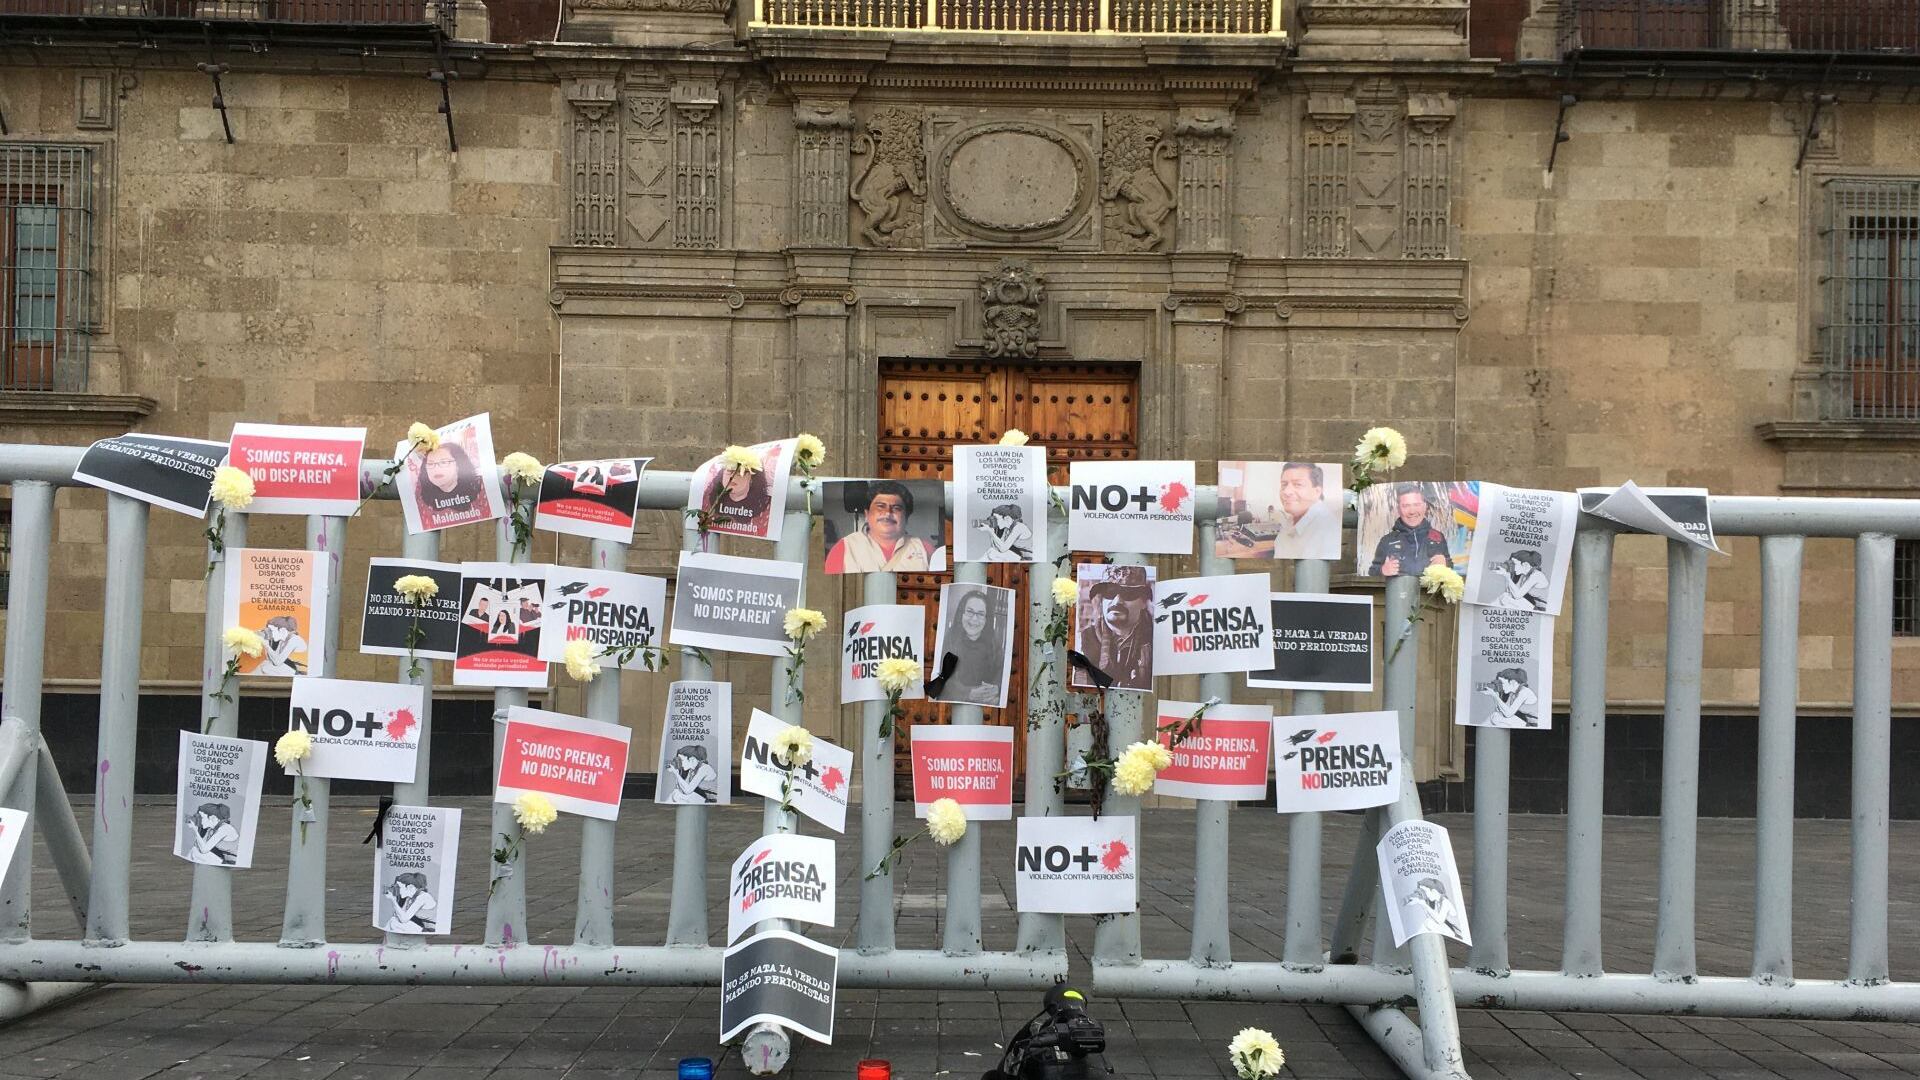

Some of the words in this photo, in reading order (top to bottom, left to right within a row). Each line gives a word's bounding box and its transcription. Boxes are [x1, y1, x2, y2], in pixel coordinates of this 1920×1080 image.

[241, 447, 290, 463] "SOMOS
[294, 451, 347, 467] PRENSA,
[250, 468, 266, 482] NO
[270, 468, 337, 484] DISPAREN"
[435, 495, 470, 509] Lourdes
[1072, 485, 1156, 511] NO+
[432, 507, 481, 525] Maldonado
[720, 503, 753, 517] Lourdes
[370, 594, 381, 602] NO
[382, 595, 392, 603] SE
[688, 582, 734, 602] "SOMOS
[736, 590, 786, 609] PRENSA,
[368, 606, 403, 616] MATANDO
[568, 599, 655, 637] PRENSA,
[694, 604, 709, 617] NO
[712, 605, 776, 624] DISPAREN"
[1172, 606, 1263, 635] PRENSA,
[1173, 633, 1259, 652] NODISPAREN
[1285, 630, 1310, 638] MATA
[1313, 630, 1325, 639] LA
[1328, 631, 1367, 640] VERDAD
[852, 636, 917, 662] PRENSA,
[1300, 642, 1368, 652] PERIODISTAS
[291, 707, 383, 738] NO+
[375, 741, 416, 749] PERIODISTAS
[1215, 738, 1258, 752] PRENSA,
[516, 739, 561, 760] "SOMOS
[564, 748, 613, 772] PRENSA,
[922, 756, 964, 771] "SOMOS
[968, 758, 1004, 773] PRENSA,
[1175, 753, 1189, 766] NO
[1193, 755, 1250, 770] DISPAREN"
[1301, 744, 1392, 772] PRENSA,
[521, 760, 537, 775] NO
[540, 763, 603, 786] DISPAREN"
[931, 776, 944, 789] NO
[947, 775, 998, 790] DISPAREN"
[1302, 771, 1387, 789] NODISPAREN
[1018, 845, 1098, 872] NO+
[743, 861, 826, 897] PRENSA,
[742, 883, 821, 913] NODISPAREN
[726, 979, 737, 991] NO
[739, 973, 749, 983] SE
[751, 964, 776, 977] MATA
[779, 965, 792, 976] LA
[794, 969, 830, 991] VERDAD
[726, 975, 761, 1003] MATANDO
[764, 975, 829, 1004] PERIODISTAS
